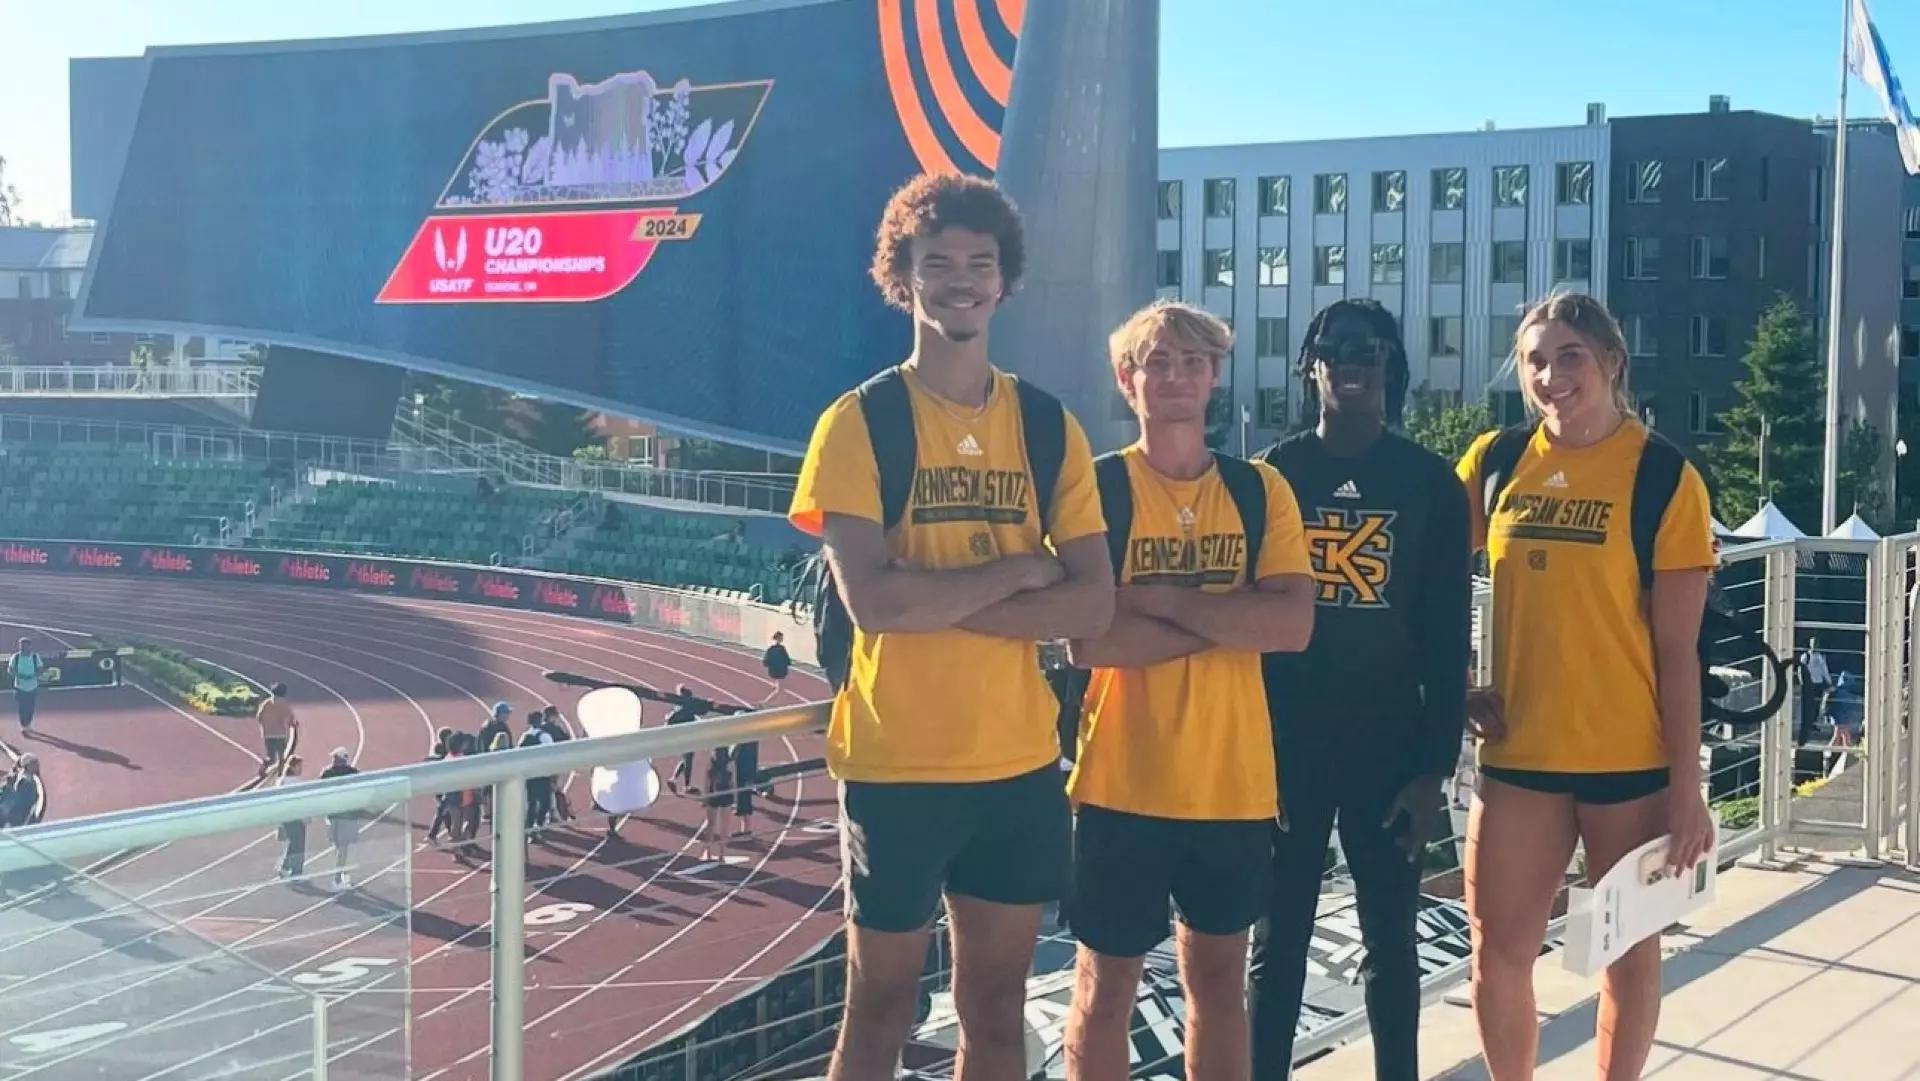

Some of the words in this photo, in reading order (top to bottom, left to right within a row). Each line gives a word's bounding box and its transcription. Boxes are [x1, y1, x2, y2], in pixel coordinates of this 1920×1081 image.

[645, 219, 687, 236] 2024
[484, 226, 543, 256] U20
[484, 256, 606, 275] CHAMPIONSHIPS
[1560, 499, 1614, 529] STATE
[0, 544, 48, 564] thletic
[1200, 532, 1244, 568] STATE
